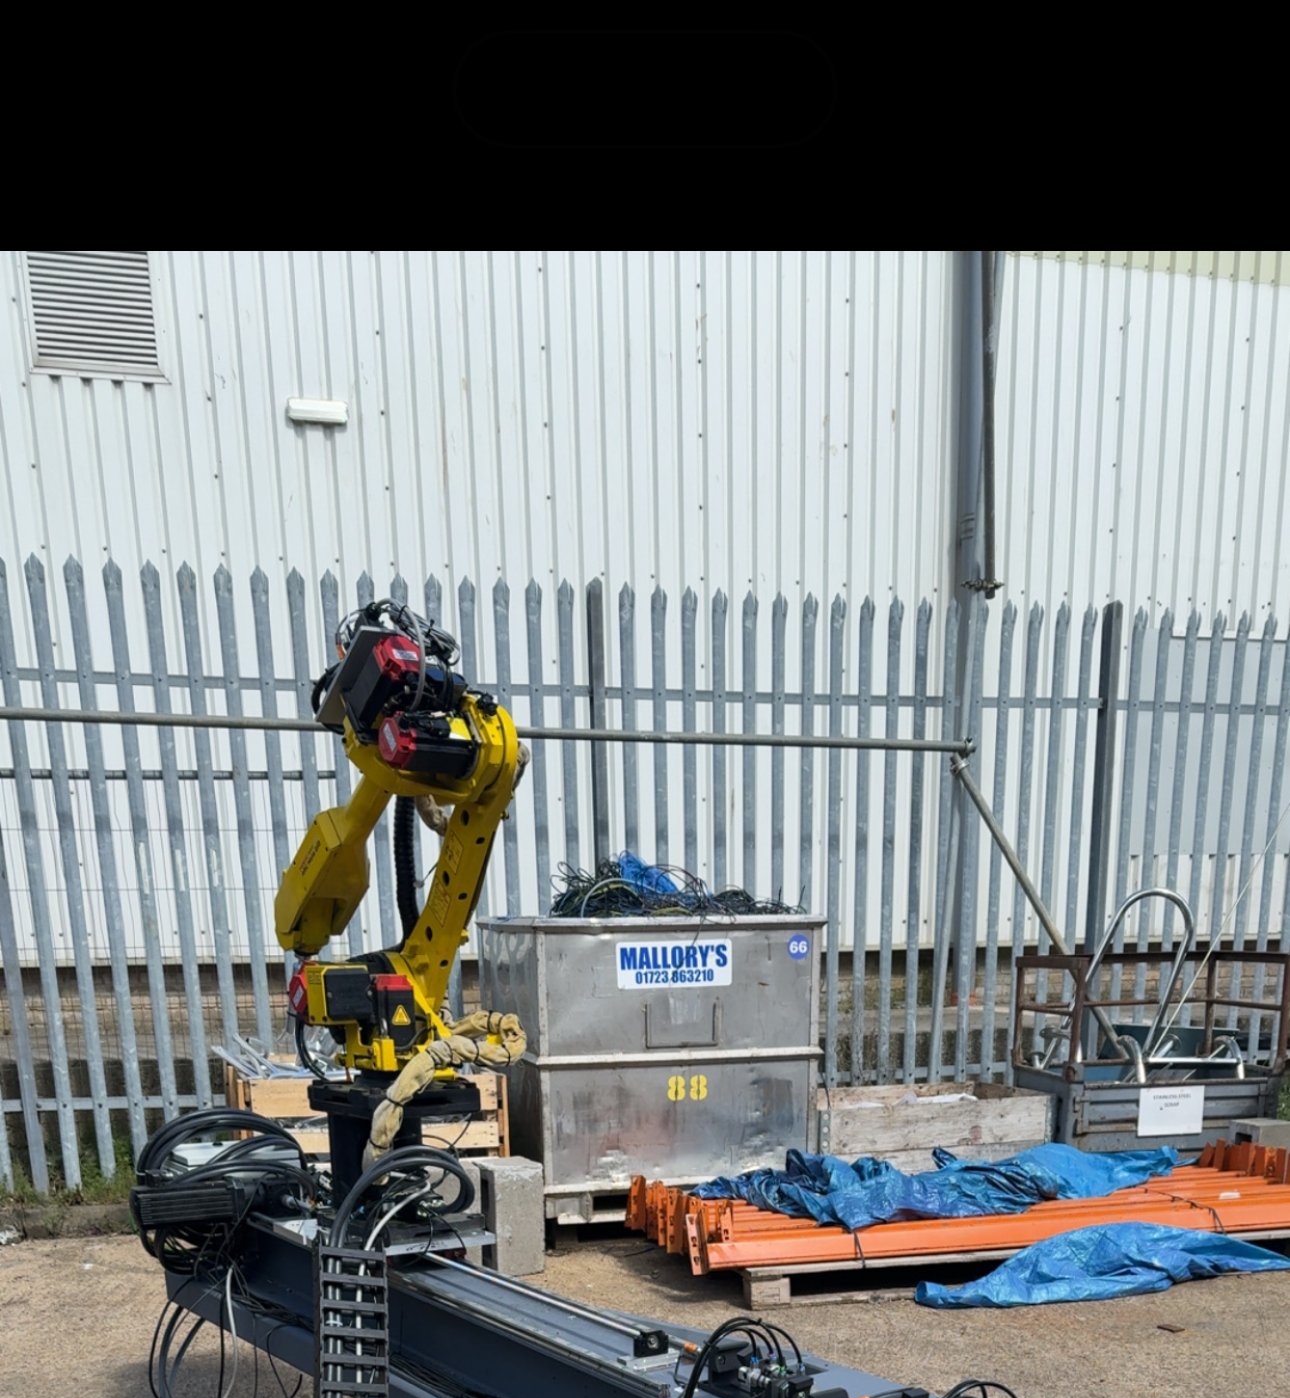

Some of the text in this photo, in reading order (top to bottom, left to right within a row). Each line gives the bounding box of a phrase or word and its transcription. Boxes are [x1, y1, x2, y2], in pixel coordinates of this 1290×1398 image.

[620, 944, 728, 971] MALLORY'S
[789, 941, 808, 954] 66
[635, 970, 670, 984] 01723
[667, 1074, 708, 1101] 88
